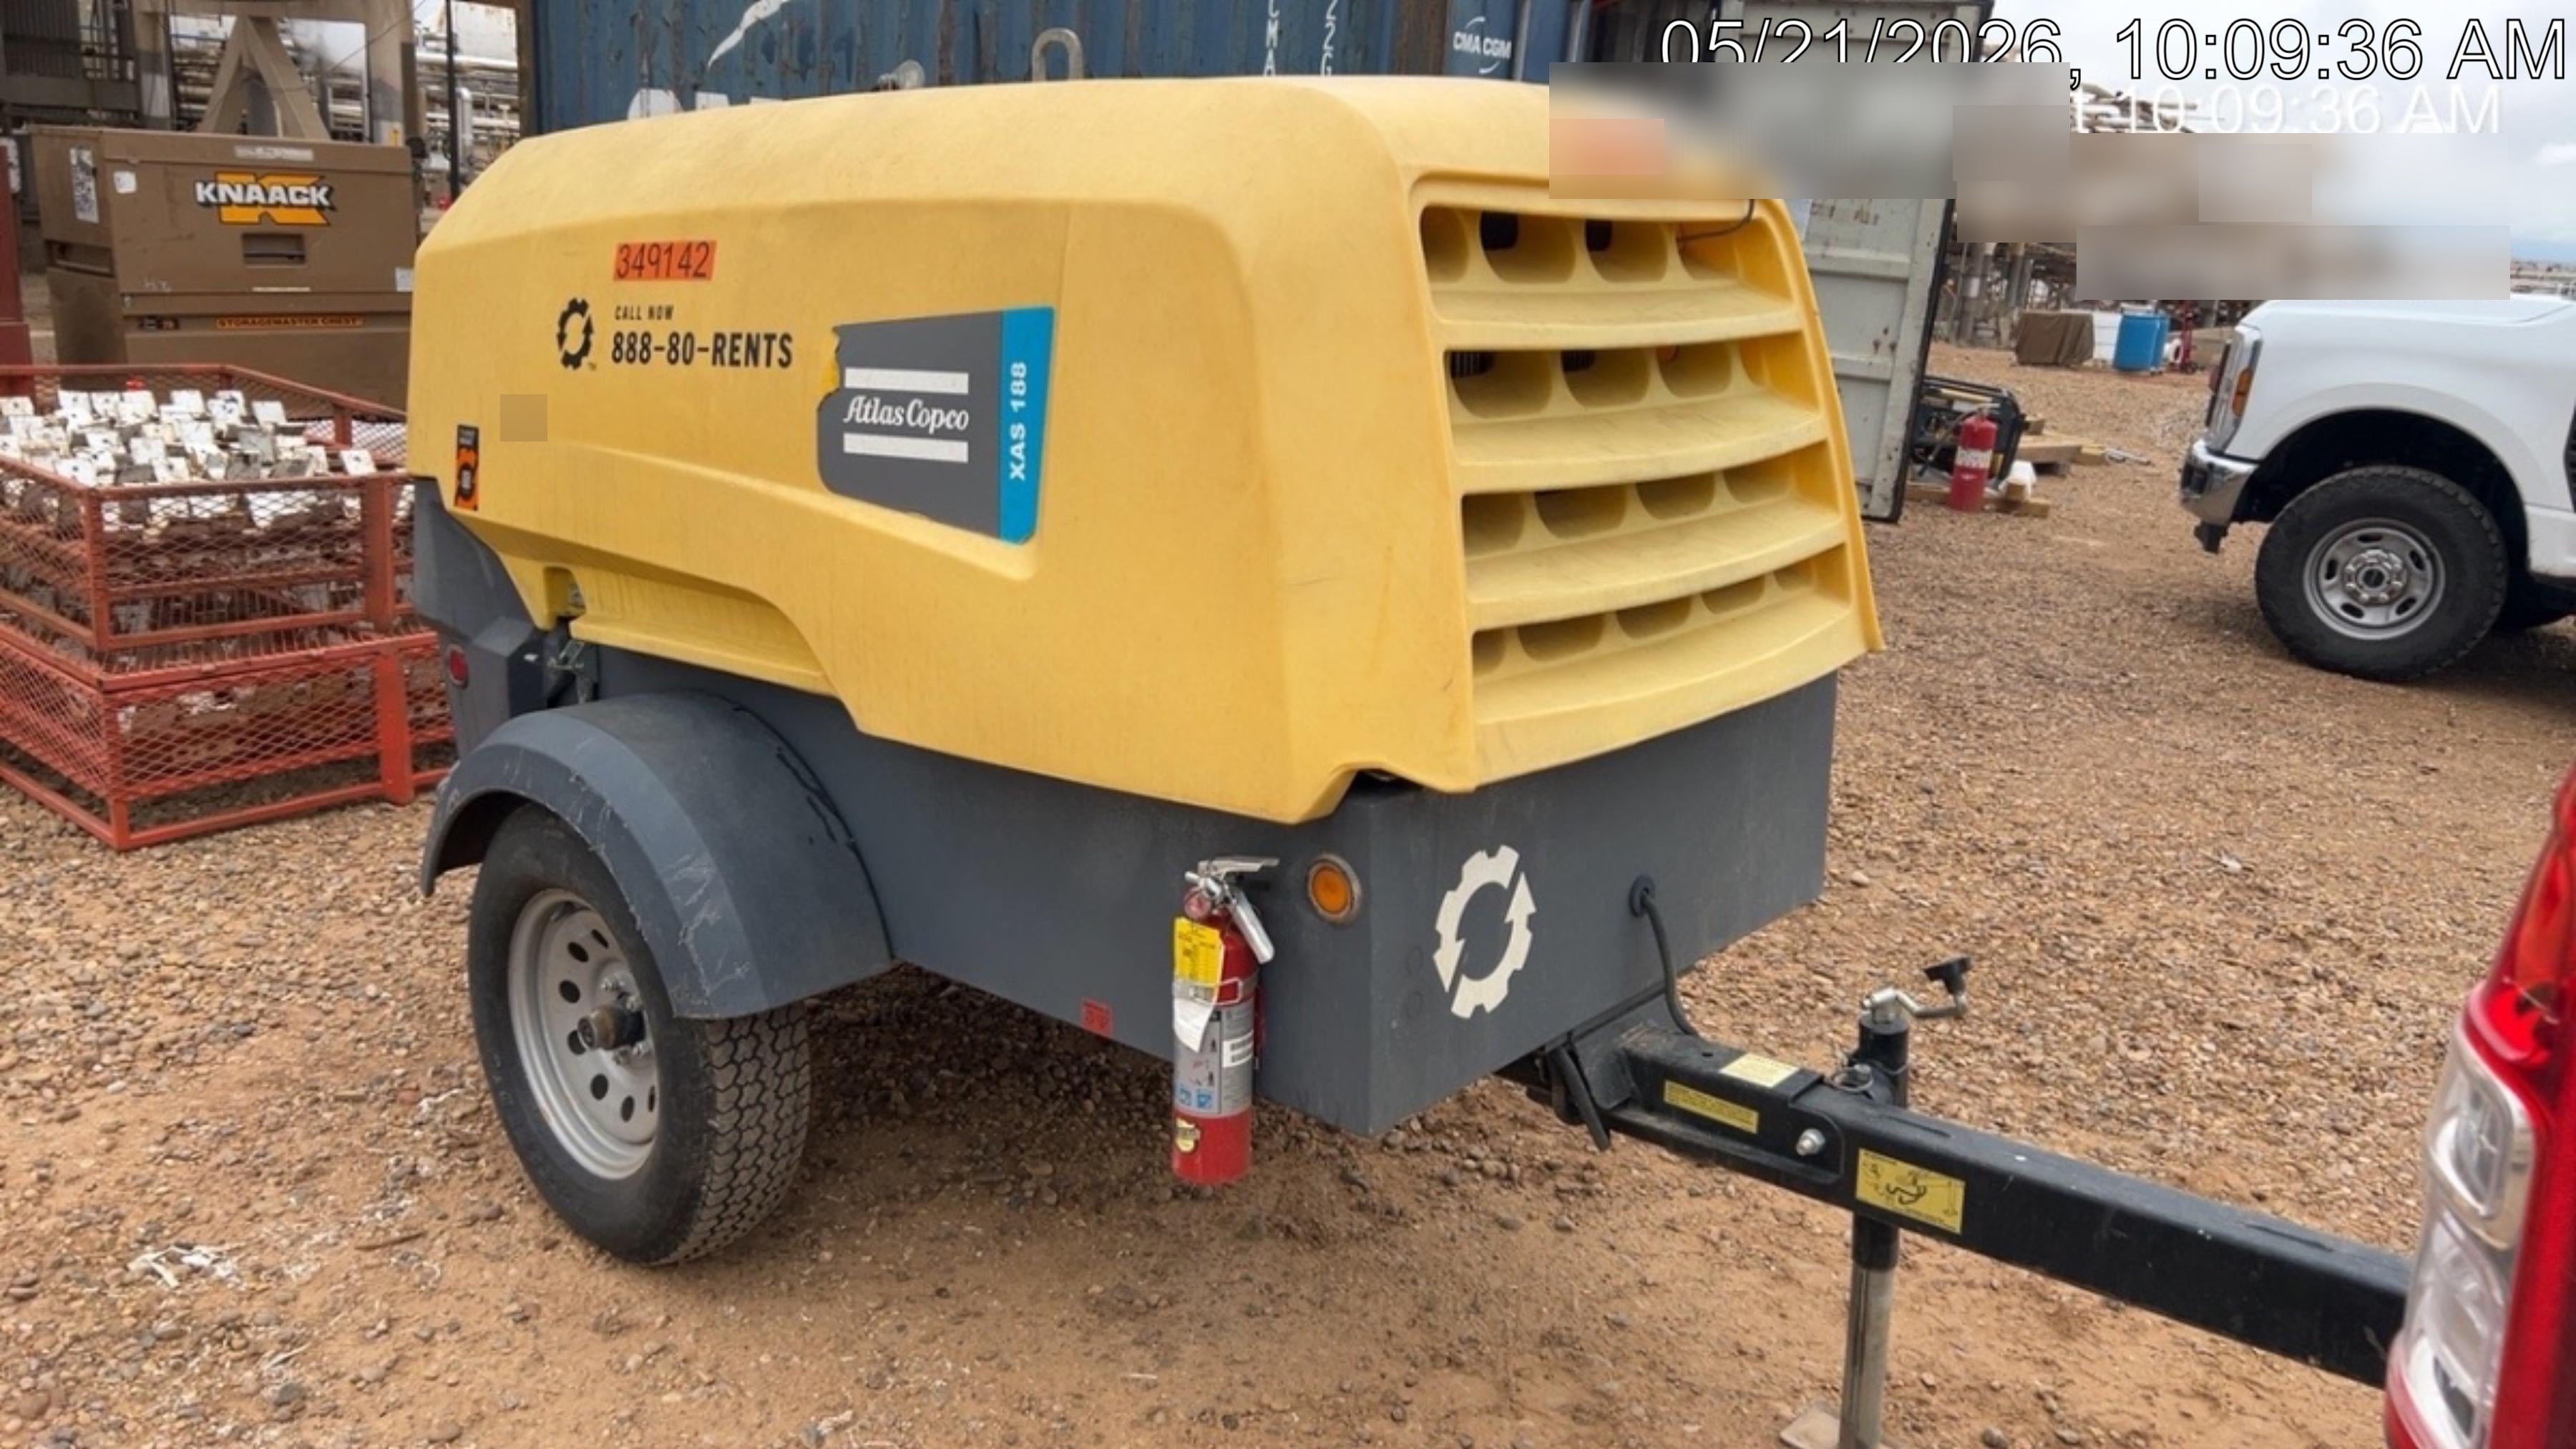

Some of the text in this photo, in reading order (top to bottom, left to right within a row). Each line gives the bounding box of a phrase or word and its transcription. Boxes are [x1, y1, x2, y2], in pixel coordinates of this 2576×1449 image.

[1453, 31, 1513, 60] CMA CGM
[194, 181, 332, 208] KNAACK
[617, 241, 710, 279] 349142
[615, 305, 675, 321] CALL NOW
[612, 331, 794, 370] 888-80-RENTS
[842, 395, 970, 434] Atlas Copco
[1008, 361, 1027, 482] XAS 188
